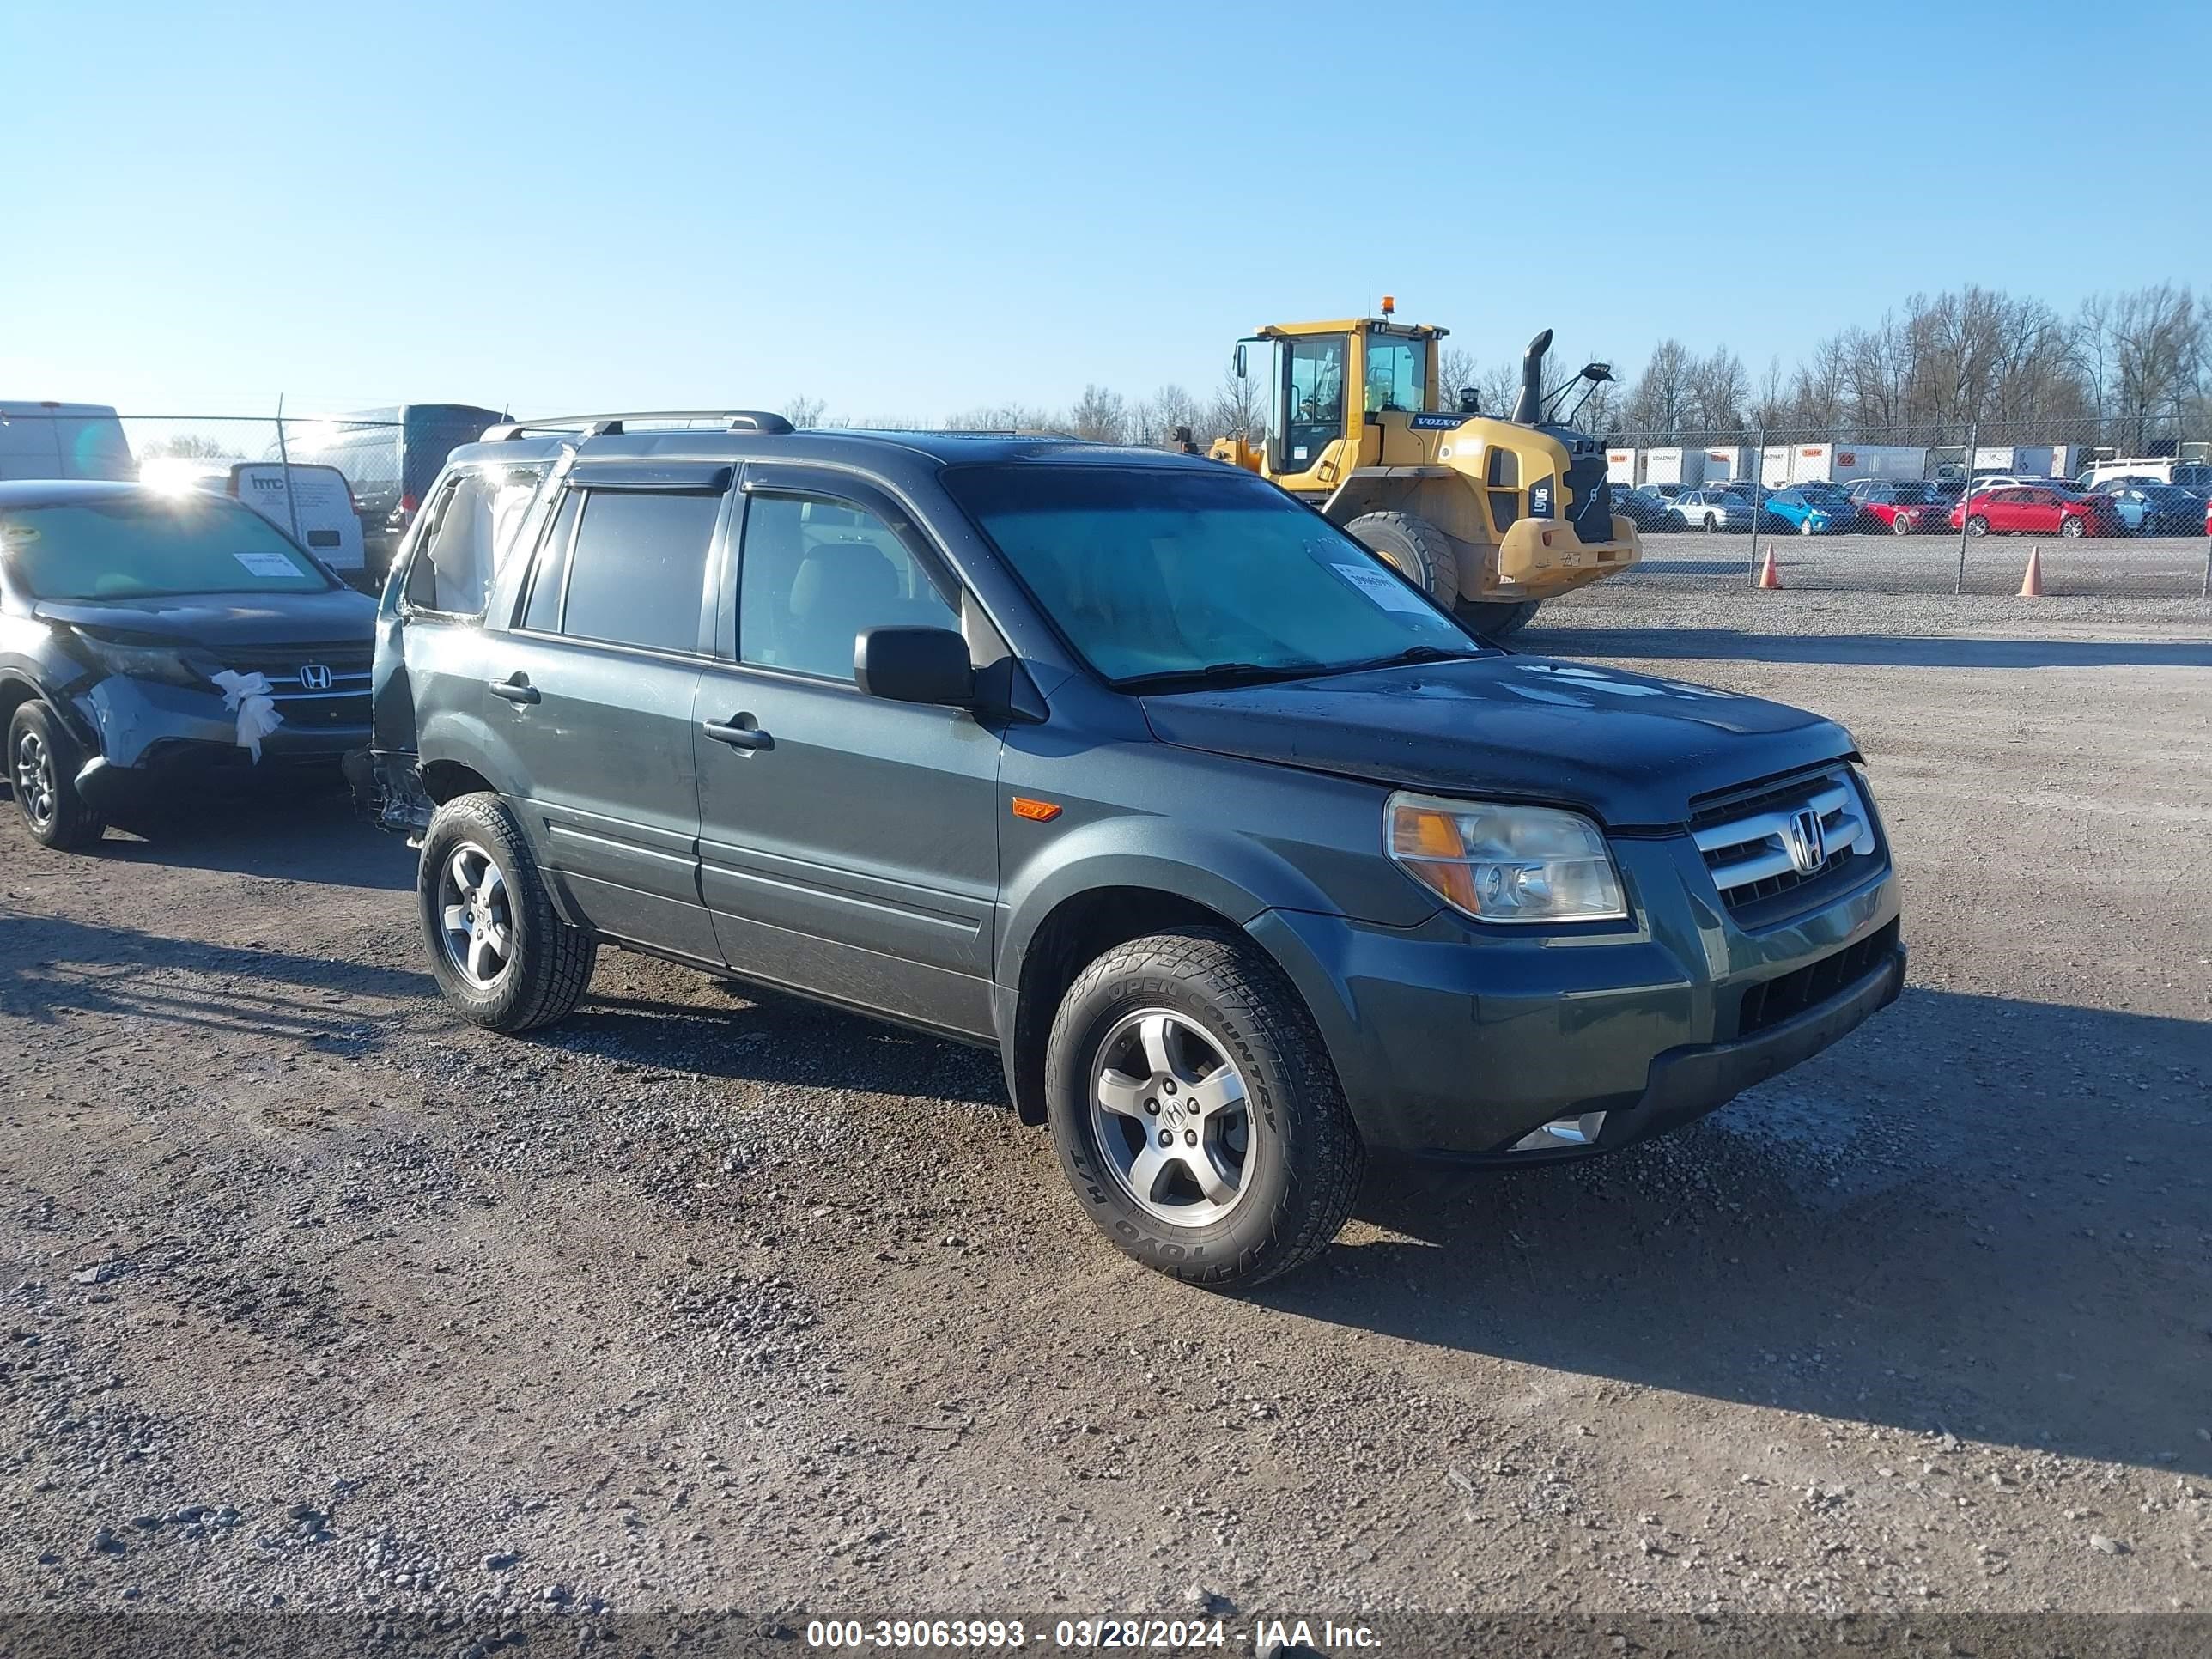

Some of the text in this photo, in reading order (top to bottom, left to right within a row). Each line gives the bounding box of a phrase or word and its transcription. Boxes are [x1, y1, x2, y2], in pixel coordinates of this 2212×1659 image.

[1534, 489, 1548, 513] L90G
[1108, 976, 1277, 1133] OPEN COUNTRY
[1115, 1220, 1210, 1262] TOYO
